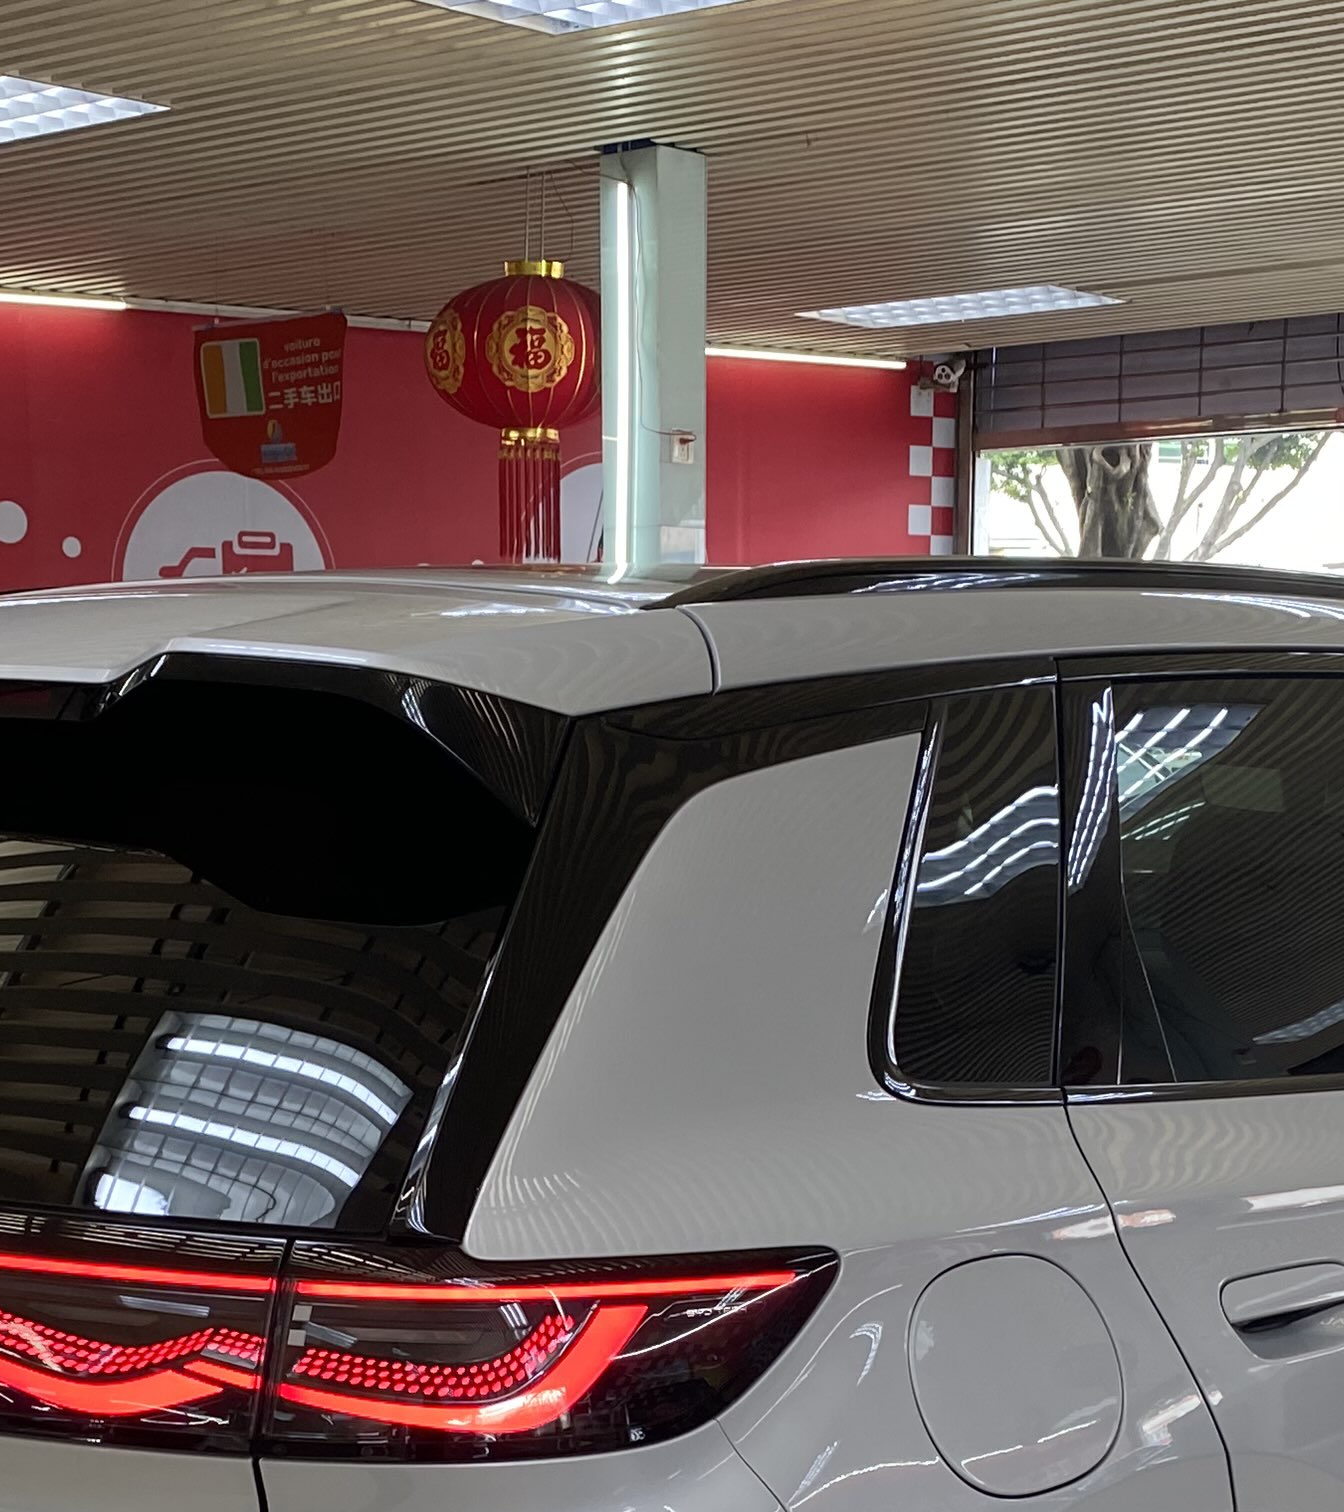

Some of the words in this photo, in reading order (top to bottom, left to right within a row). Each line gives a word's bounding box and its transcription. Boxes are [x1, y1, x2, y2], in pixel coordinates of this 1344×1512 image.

[509, 326, 552, 370] 福
[268, 381, 341, 409] 二手车出口
